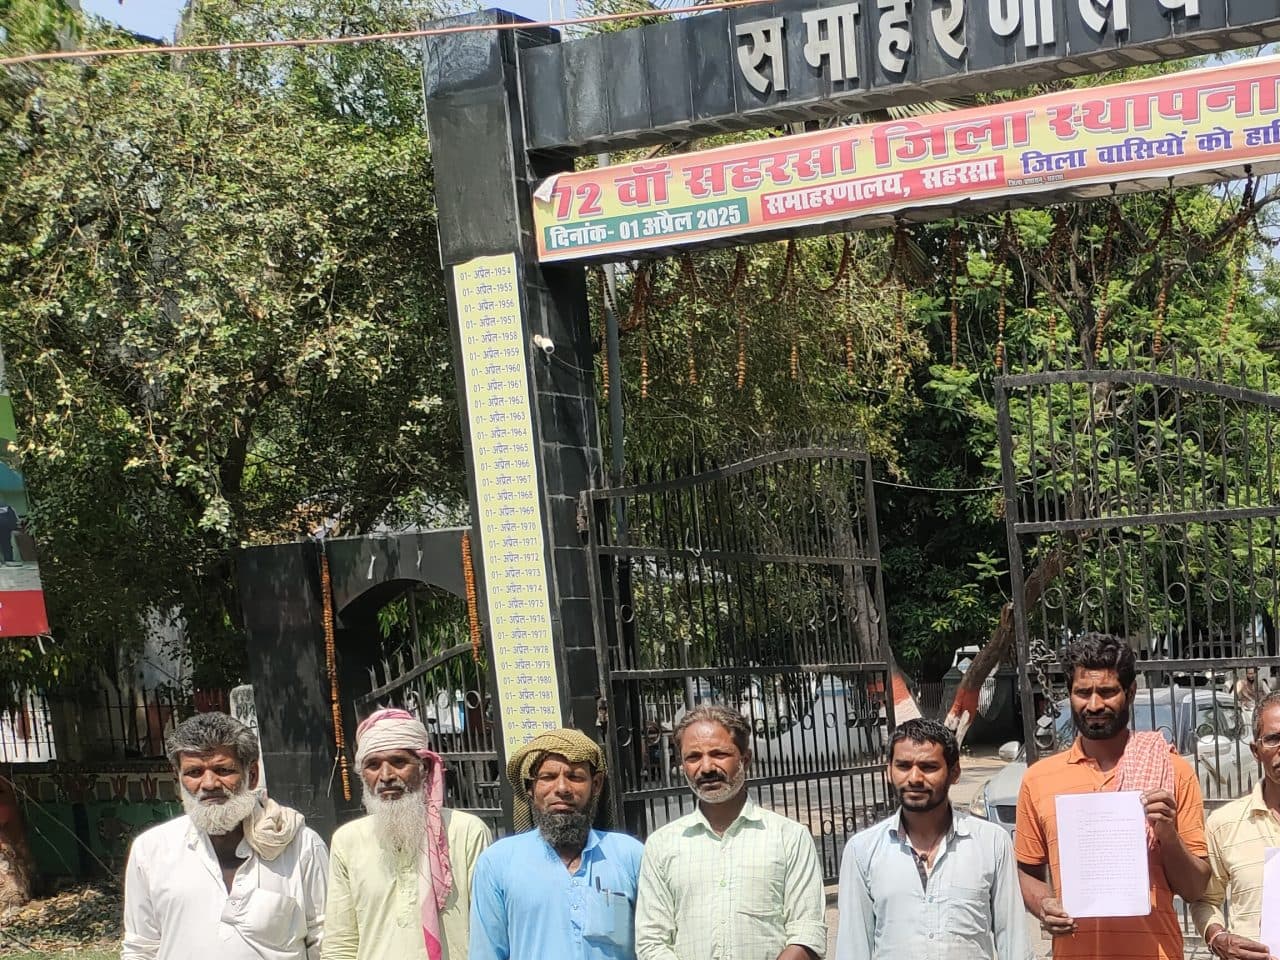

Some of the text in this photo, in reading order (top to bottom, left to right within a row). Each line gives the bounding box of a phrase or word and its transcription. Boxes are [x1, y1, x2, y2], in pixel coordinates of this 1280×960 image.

[1020, 149, 1087, 175] जिला
[1096, 130, 1188, 164] वासियों
[1196, 127, 1233, 152] को
[552, 183, 603, 220] 72
[682, 138, 859, 197] सहरसा
[871, 110, 1036, 169] जिला
[764, 160, 998, 214] समाहरणालय, सहरसा
[550, 205, 741, 249] दिनांक- 01 अप्रैल 2025
[460, 272, 471, 281] 01-
[466, 320, 477, 329] 01-
[471, 368, 483, 376] 01-
[476, 415, 487, 424] 01-
[480, 462, 492, 471] 01-
[489, 540, 500, 548] 01-
[496, 615, 508, 624] 01-
[505, 691, 517, 701] 01-
